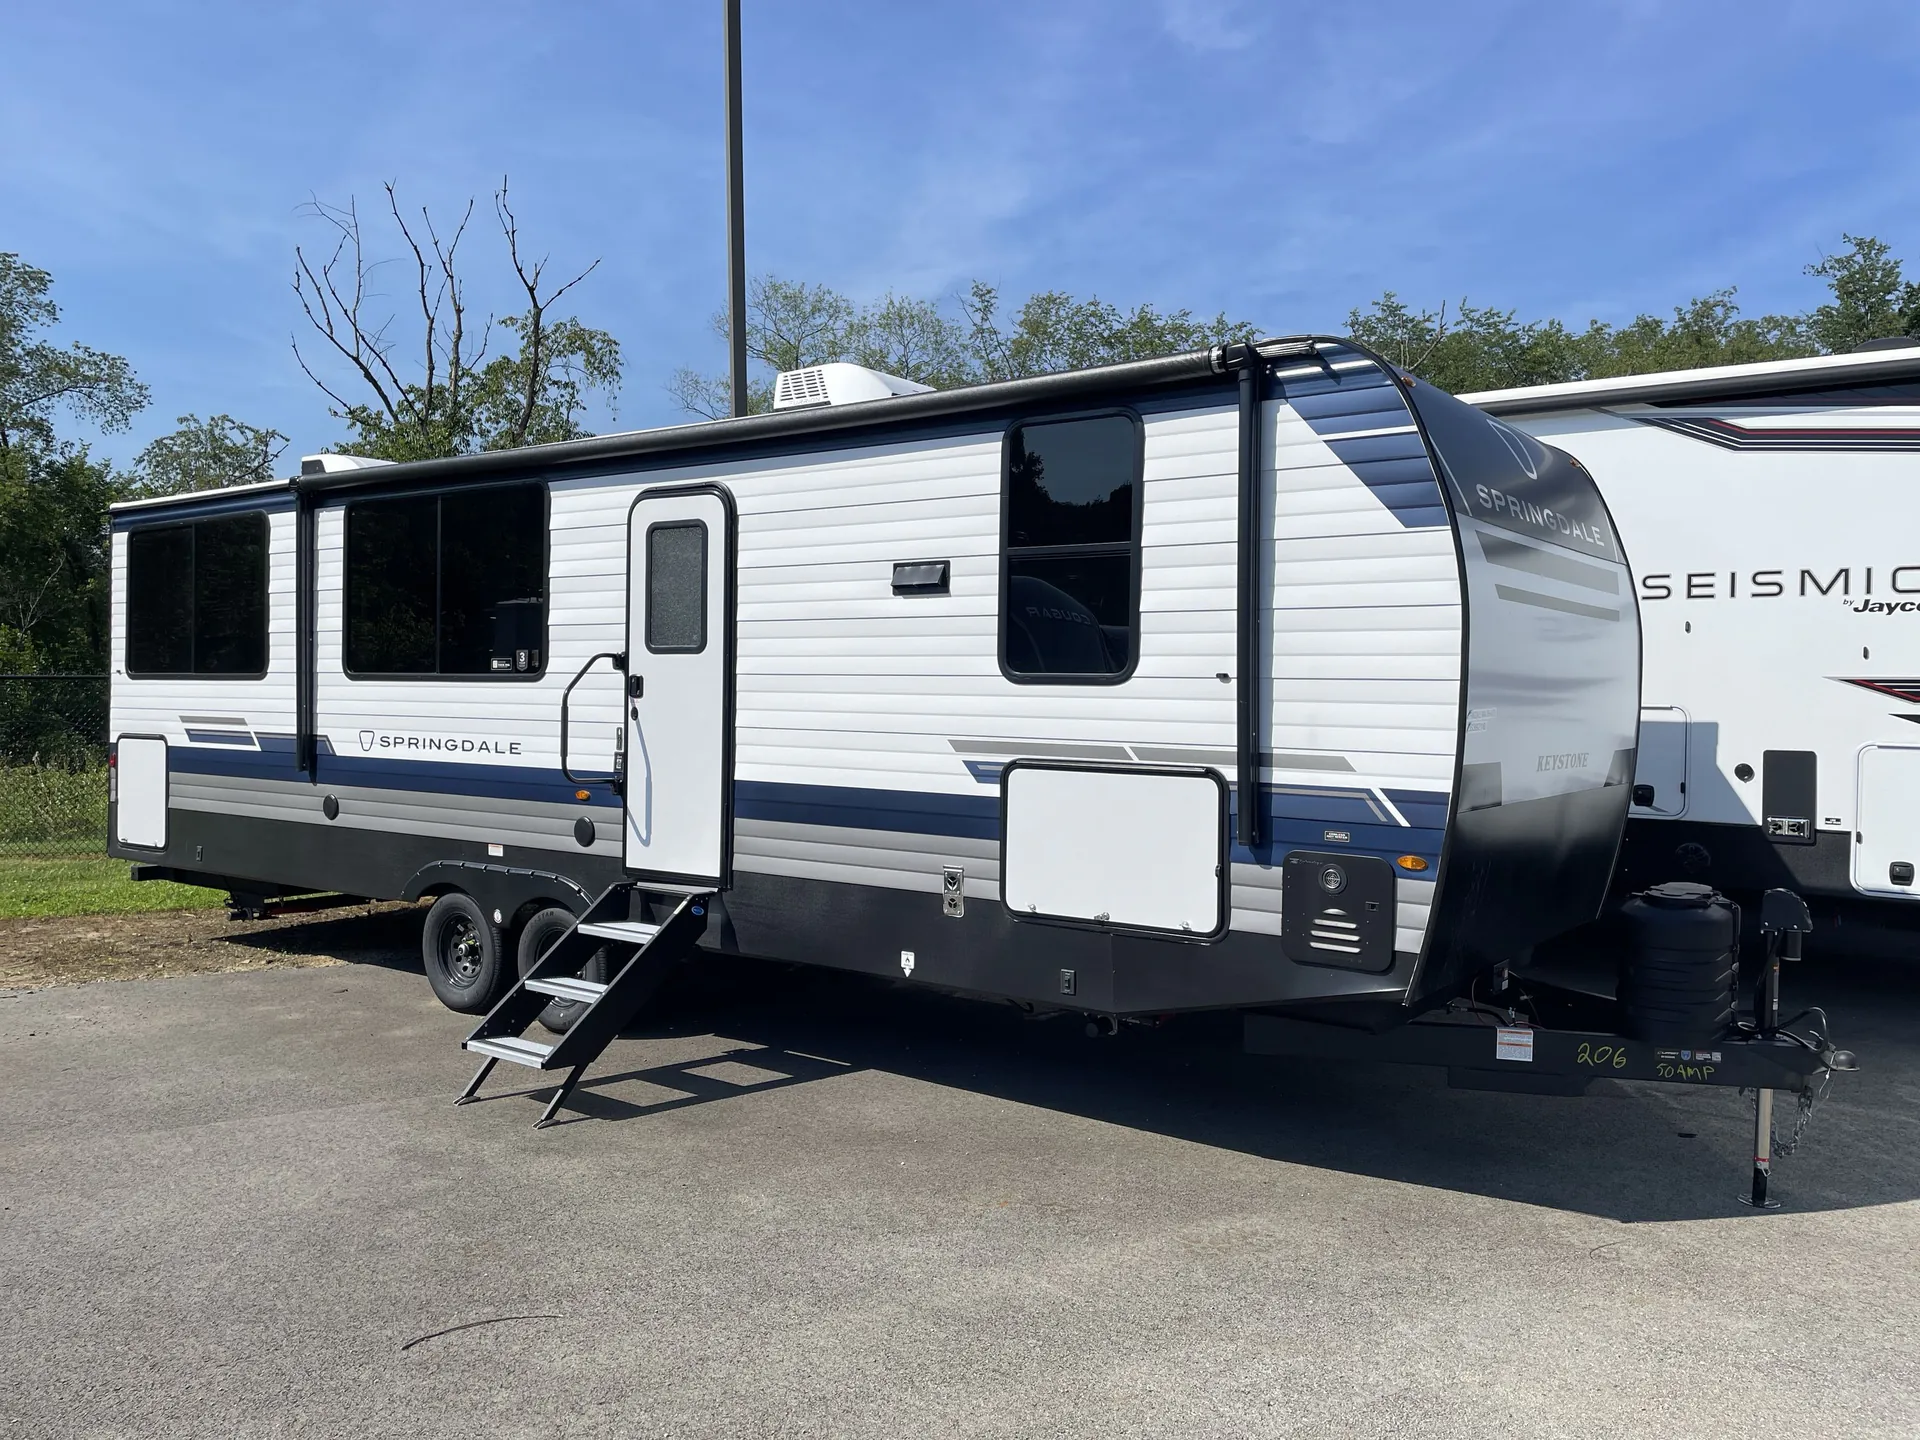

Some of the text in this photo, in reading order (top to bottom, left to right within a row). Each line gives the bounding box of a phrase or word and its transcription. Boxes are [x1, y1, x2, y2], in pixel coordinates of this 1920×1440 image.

[1475, 483, 1605, 547] SPRINGDALE
[1640, 565, 1920, 600] SEISMIC
[1843, 598, 1855, 607] by
[519, 652, 526, 662] 3
[379, 735, 522, 755] SPRINGDALE
[1536, 752, 1590, 772] KEYSTONE
[1576, 1042, 1627, 1069] 206
[1676, 1064, 1715, 1080] AMP
